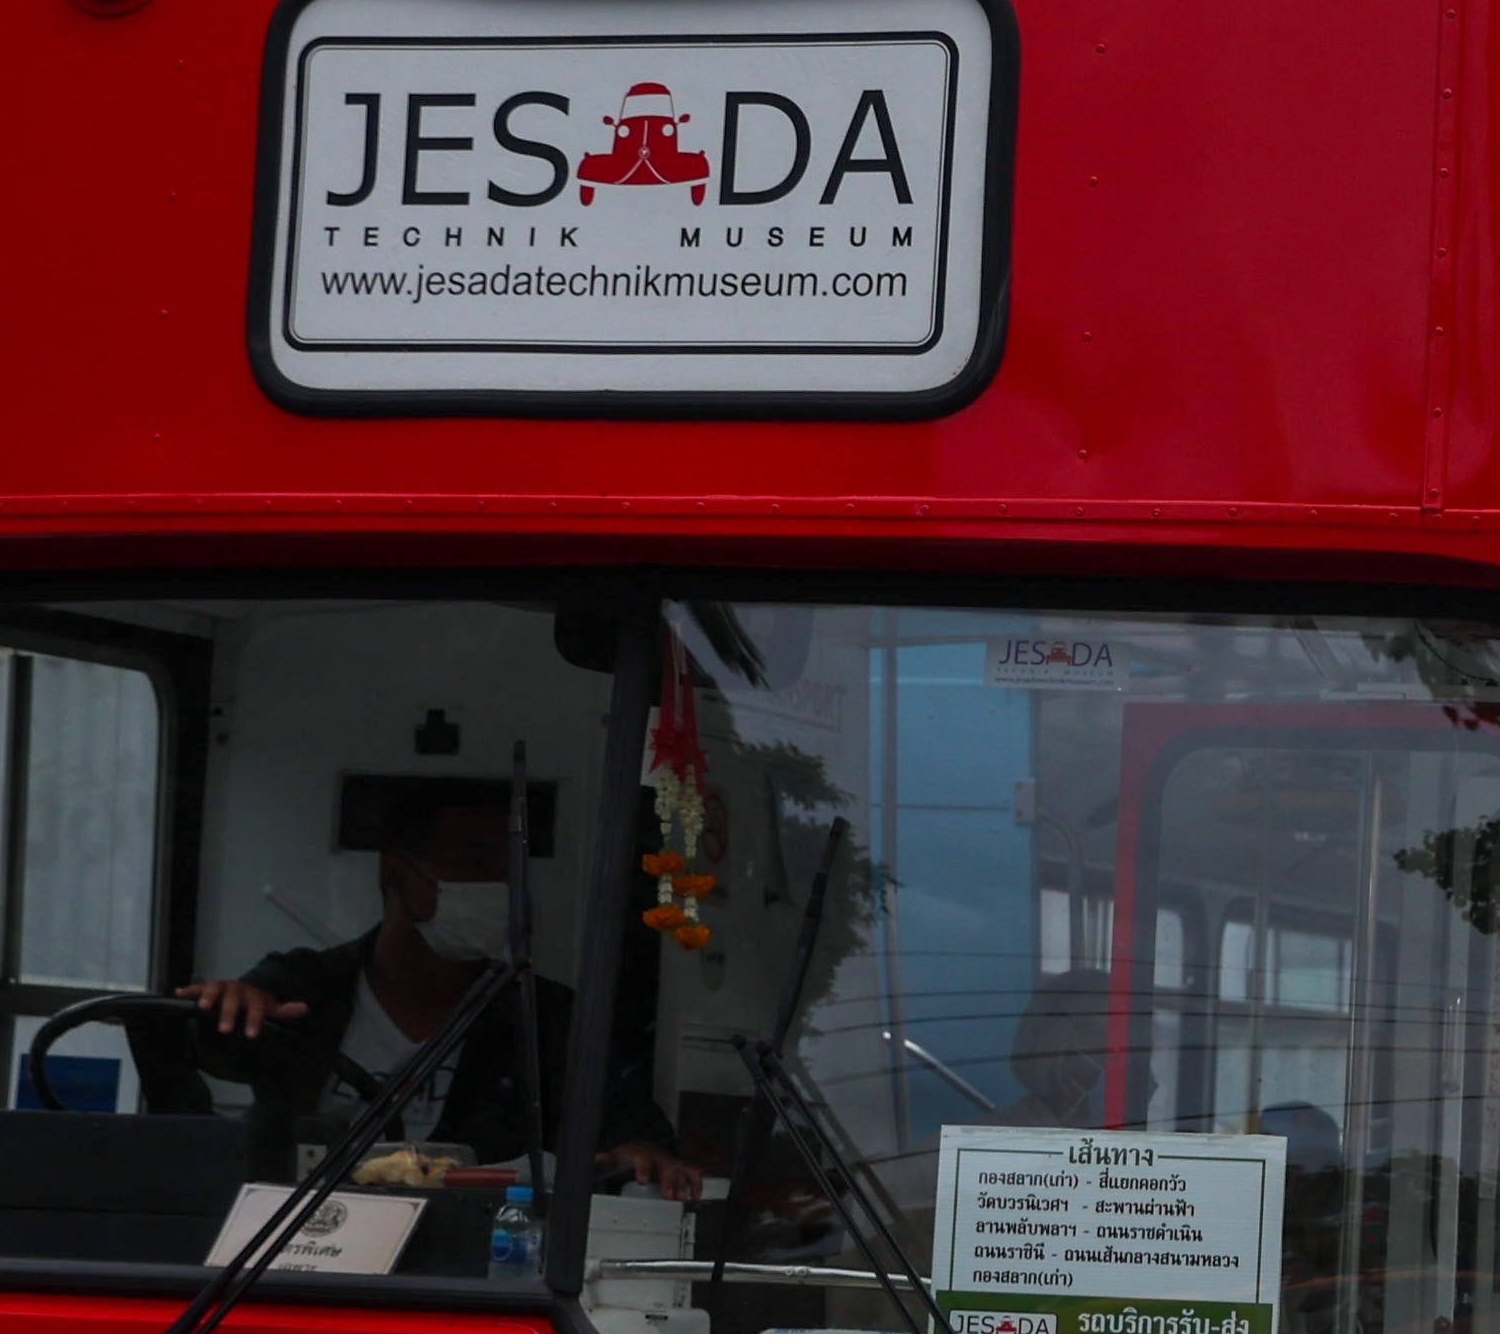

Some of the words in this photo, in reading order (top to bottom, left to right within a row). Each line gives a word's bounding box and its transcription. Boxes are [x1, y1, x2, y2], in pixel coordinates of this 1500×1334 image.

[325, 225, 581, 248] TECHNIK
[680, 225, 914, 248] MUSEUM
[320, 263, 908, 305] www.jesadatechnikmuseum.com
[1068, 1137, 1155, 1167] เส้นทาง
[978, 1169, 1079, 1190] กองสลาก(เก่า)
[1098, 1168, 1187, 1193] สี่แยกคอกวัว
[978, 1189, 1069, 1213] วัดบวรนิเวศฯ
[1095, 1196, 1195, 1218] สะพานผ่านฟ้า
[975, 1216, 1077, 1239] ลานพลับพลาฯ
[1096, 1222, 1203, 1244] ถนนราชดำเนิน
[973, 1241, 1045, 1261] ถนนราชินี
[1064, 1244, 1239, 1270] ถนนเส้นกลางสนามหลวง
[972, 1266, 1073, 1289] กองสลาก(เก่า)
